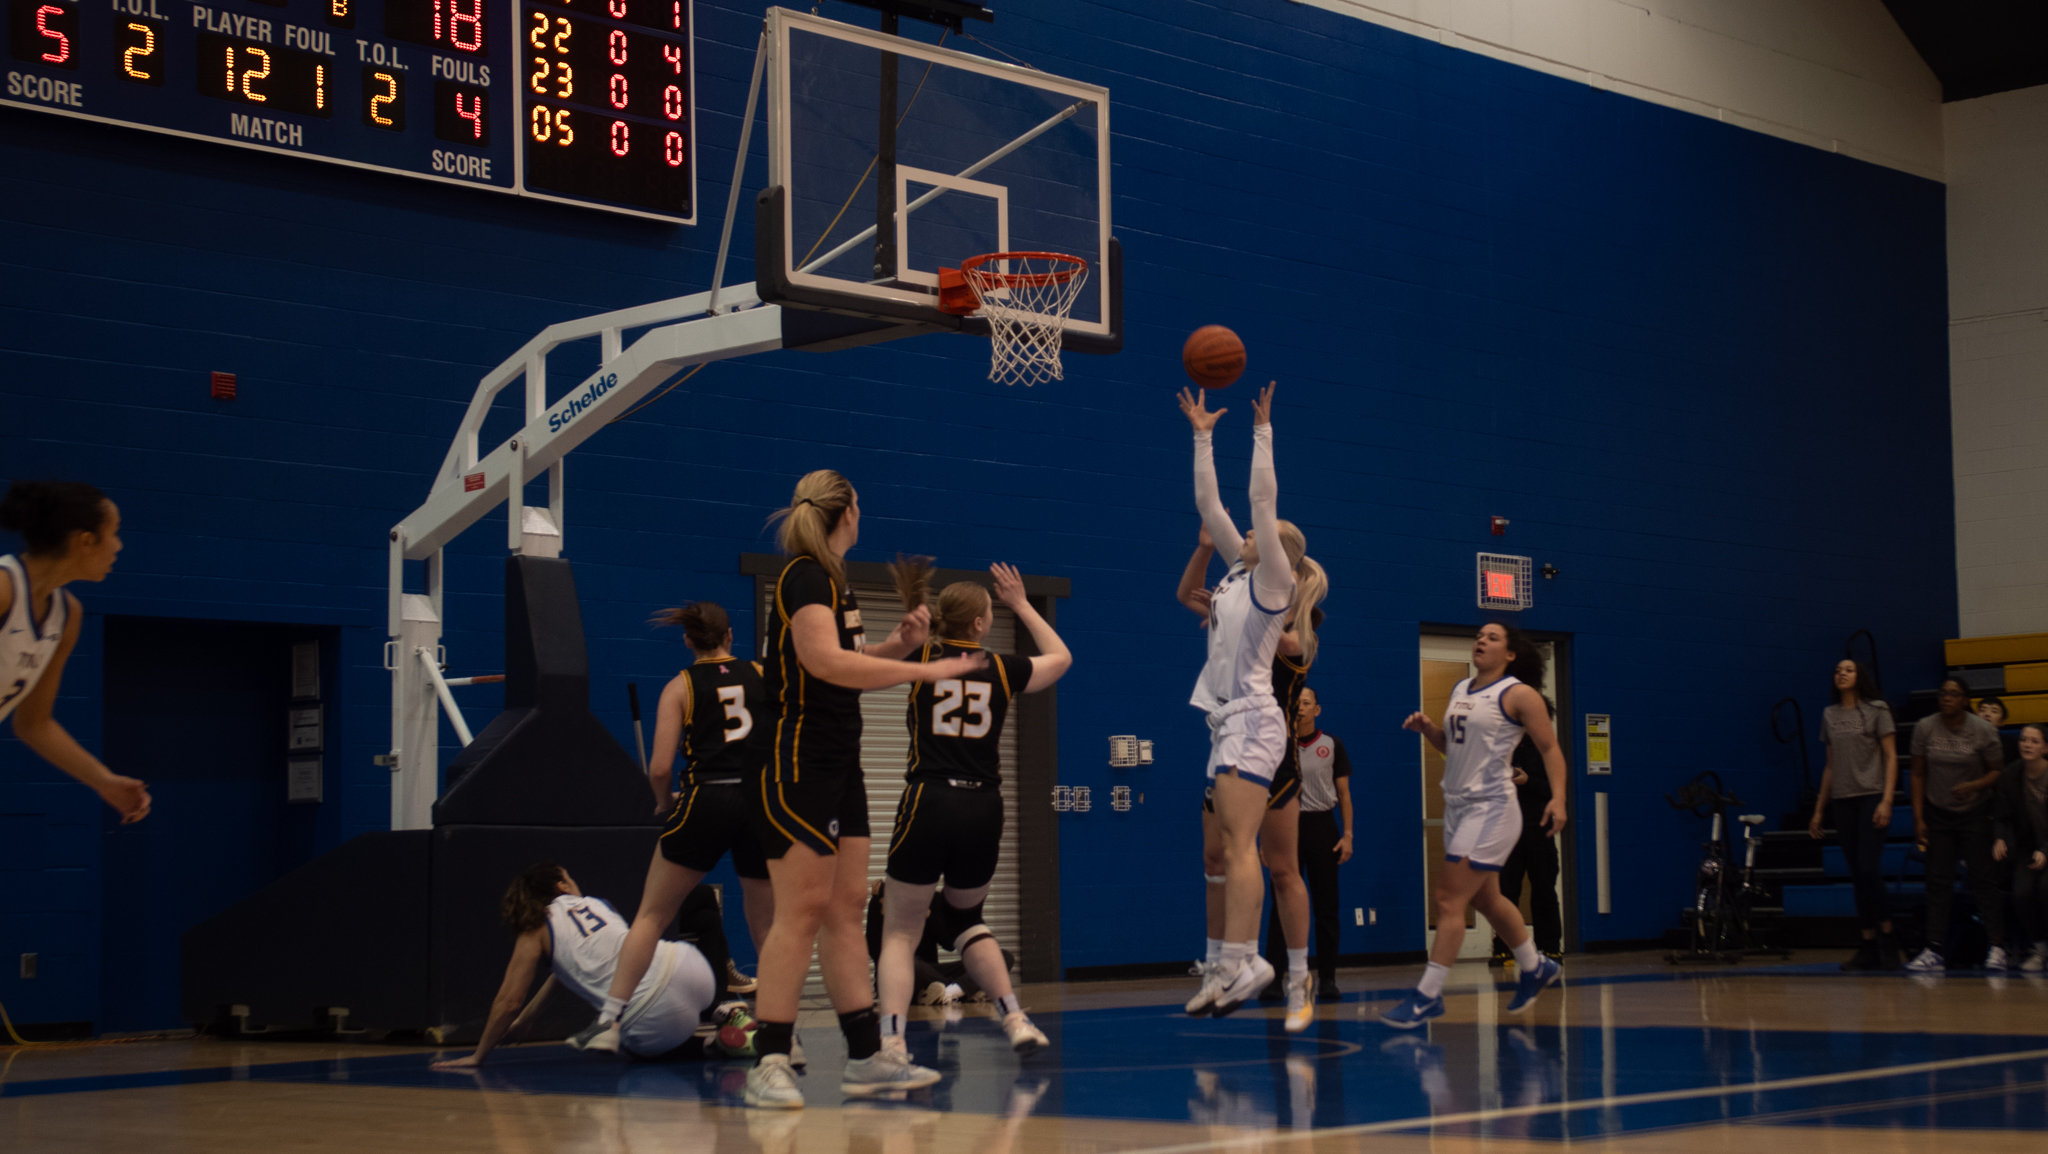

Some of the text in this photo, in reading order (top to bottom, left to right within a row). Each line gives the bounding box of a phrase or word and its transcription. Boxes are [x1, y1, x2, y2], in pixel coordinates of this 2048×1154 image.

[36, 4, 70, 64] 5
[124, 22, 155, 80] 2
[193, 5, 336, 57] PLAYER FOUL
[356, 39, 409, 71] T.O.L.
[530, 11, 682, 75] 22 0 4
[6, 70, 84, 108] SCORE
[225, 46, 325, 110] 12 1
[432, 54, 492, 88] FOULS
[531, 56, 682, 121] 23 0 0
[370, 71, 397, 126] 2
[456, 92, 482, 140] 4
[230, 112, 304, 147] MATCH
[531, 104, 683, 168] 05 0 0
[432, 148, 492, 181] SCORE
[548, 372, 618, 433] Schelde
[1490, 572, 1513, 598] EXIT
[716, 684, 754, 743] 3
[932, 679, 993, 739] 23
[1449, 714, 1468, 744] 15
[567, 905, 607, 938] 13
